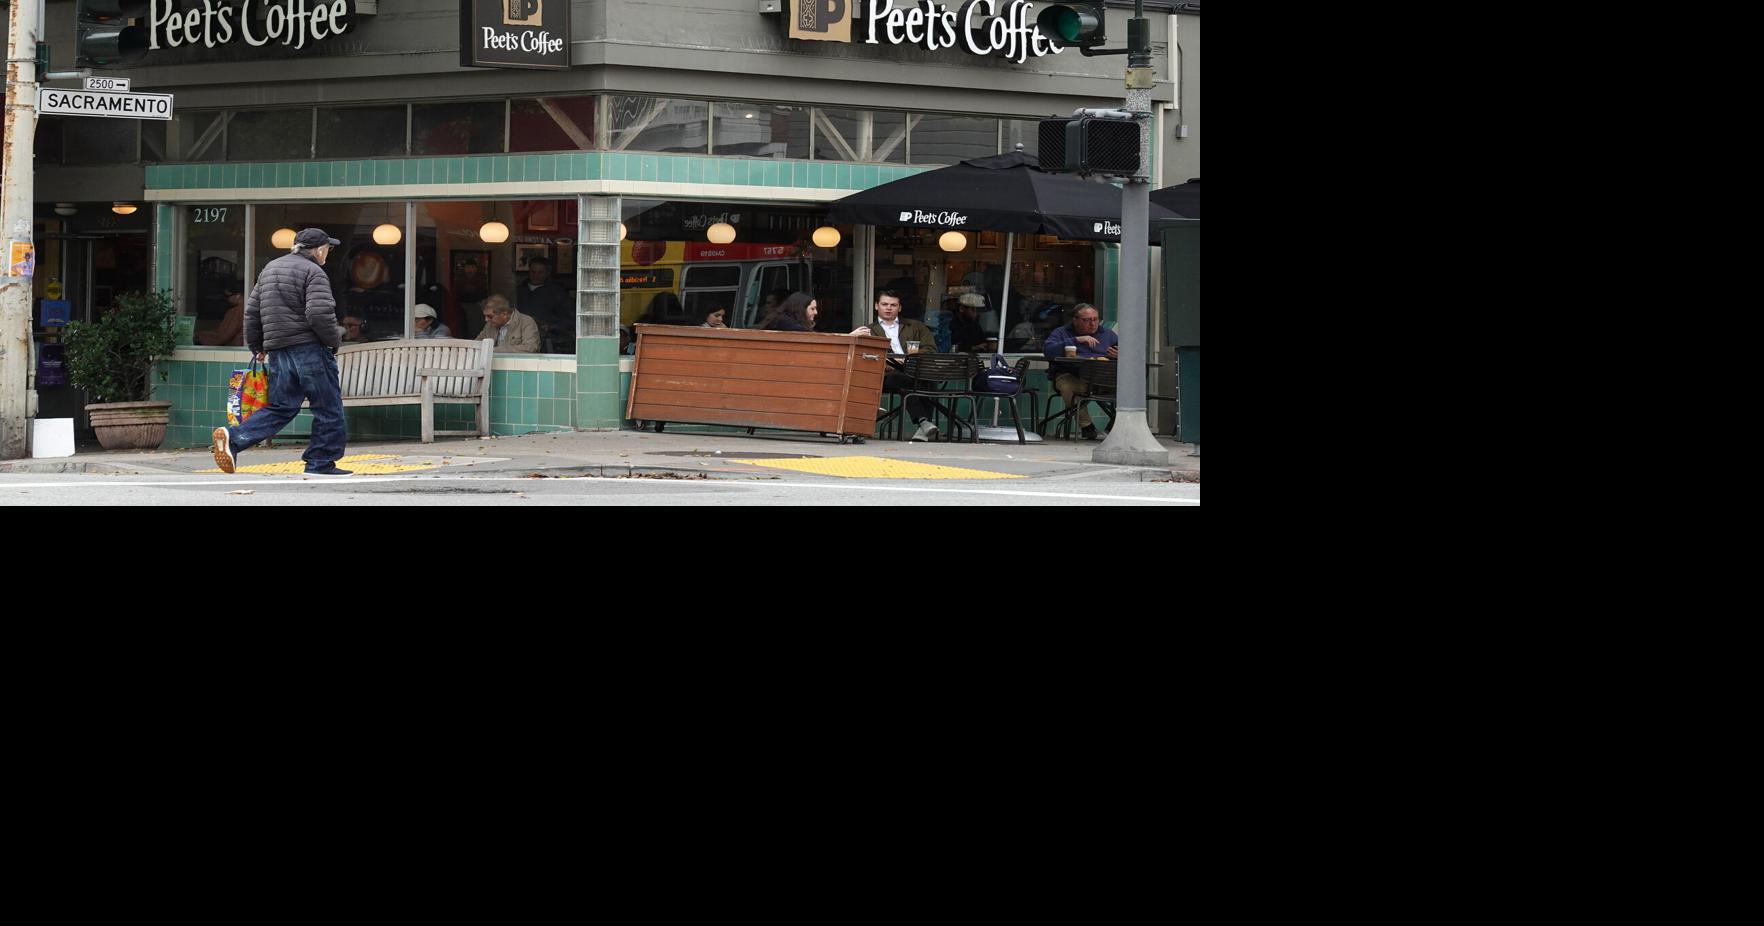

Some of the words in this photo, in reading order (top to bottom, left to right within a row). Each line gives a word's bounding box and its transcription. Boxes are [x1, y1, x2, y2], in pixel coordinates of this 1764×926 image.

[149, 0, 233, 50] Peet's
[241, 0, 348, 50] Coffee
[865, 0, 957, 51] Peet's
[481, 26, 519, 51] Peet's
[520, 30, 563, 56] Coffee
[89, 78, 114, 90] 2500
[47, 93, 168, 114] SACRAMENTO
[193, 207, 228, 223] 2197
[937, 211, 968, 227] Coffee
